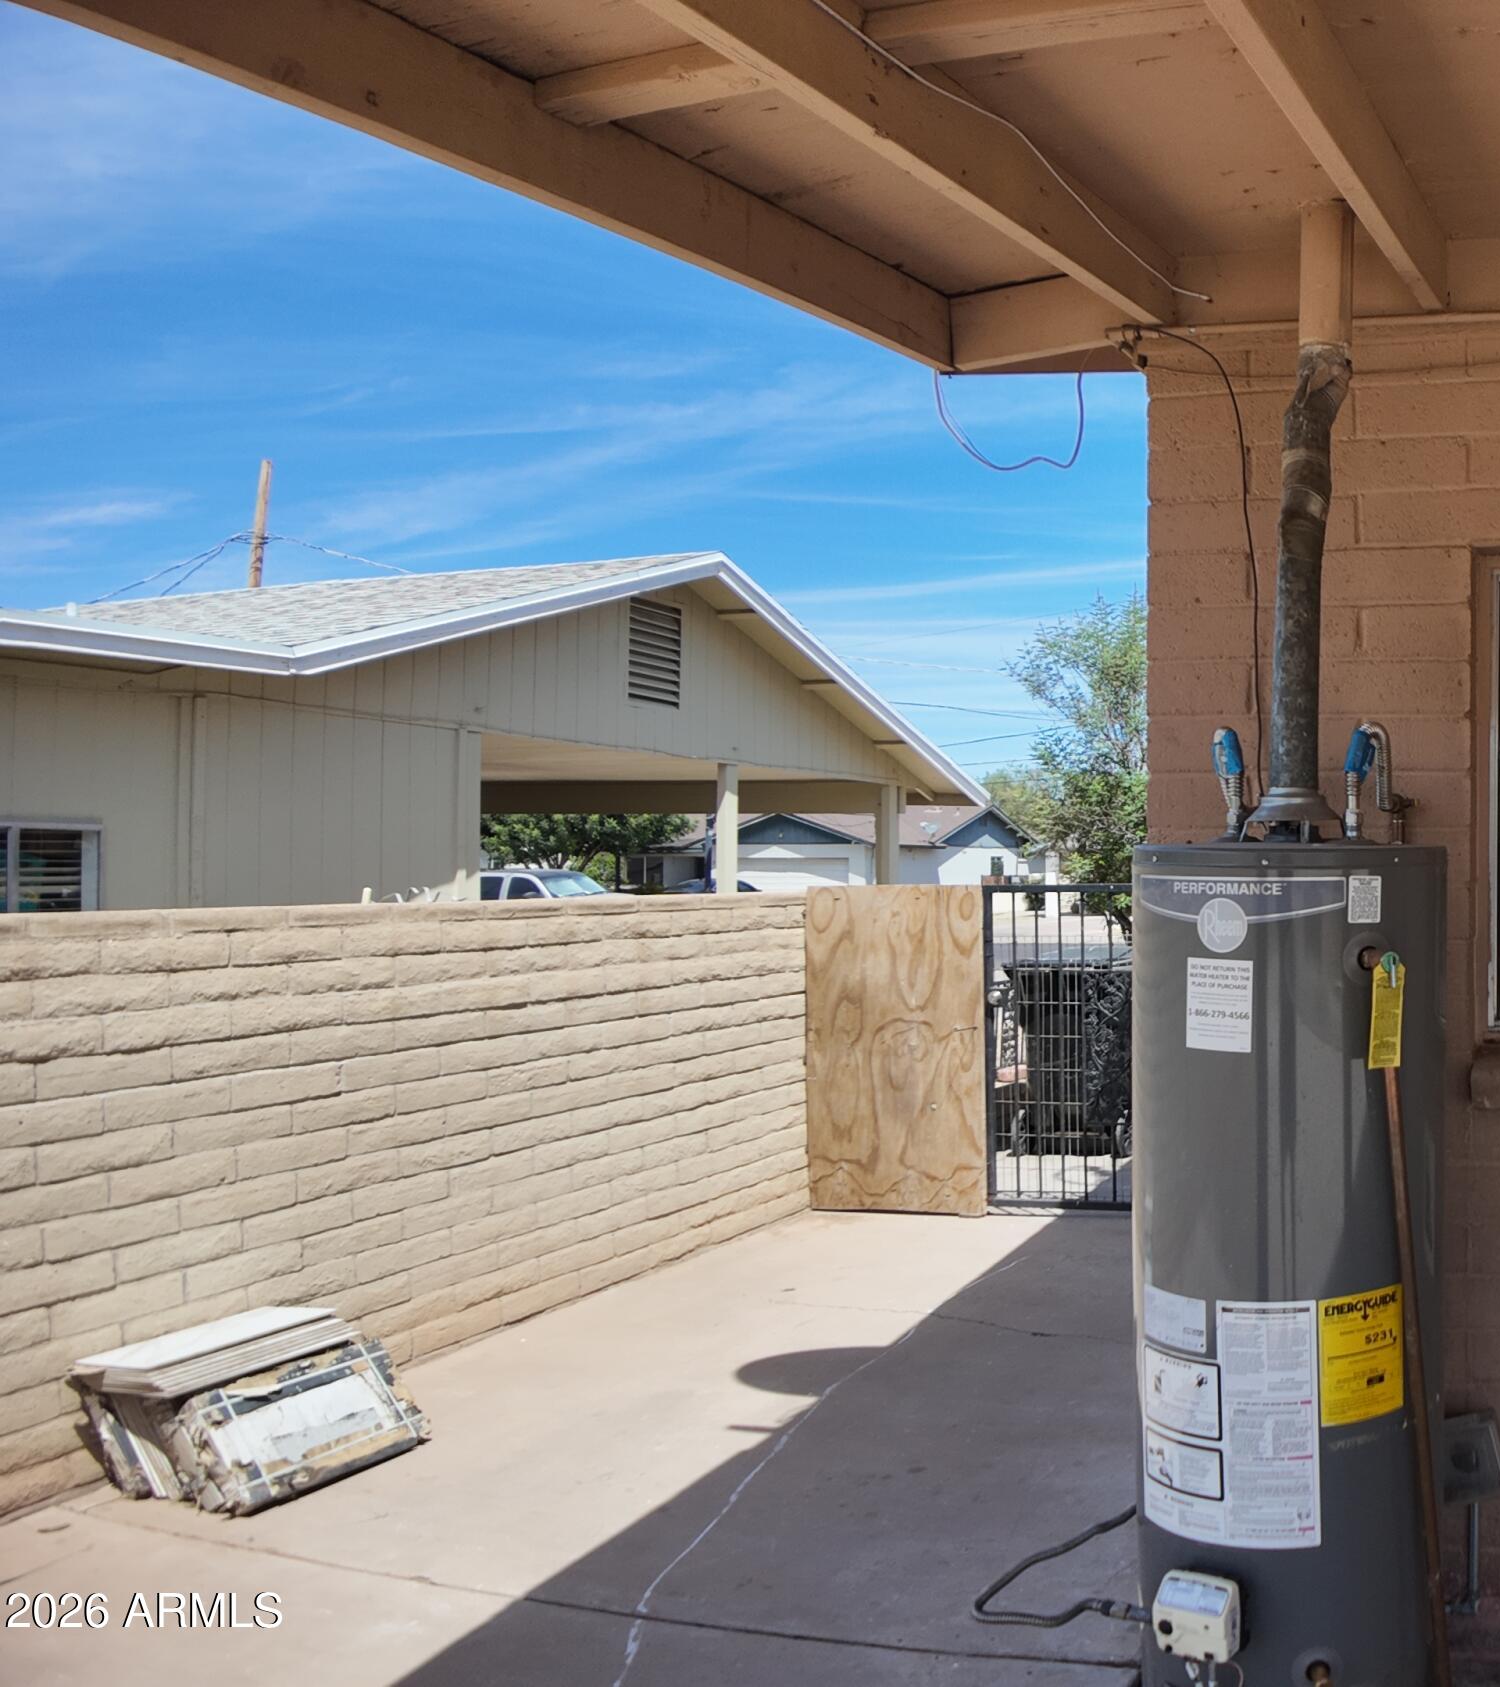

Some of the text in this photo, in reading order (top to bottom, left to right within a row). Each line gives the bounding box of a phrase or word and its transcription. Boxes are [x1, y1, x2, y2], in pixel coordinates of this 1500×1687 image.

[1173, 882, 1283, 895] PERFORMANCE
[1203, 901, 1243, 944] Rheem
[1189, 1008, 1250, 1020] 1-866-279-4566
